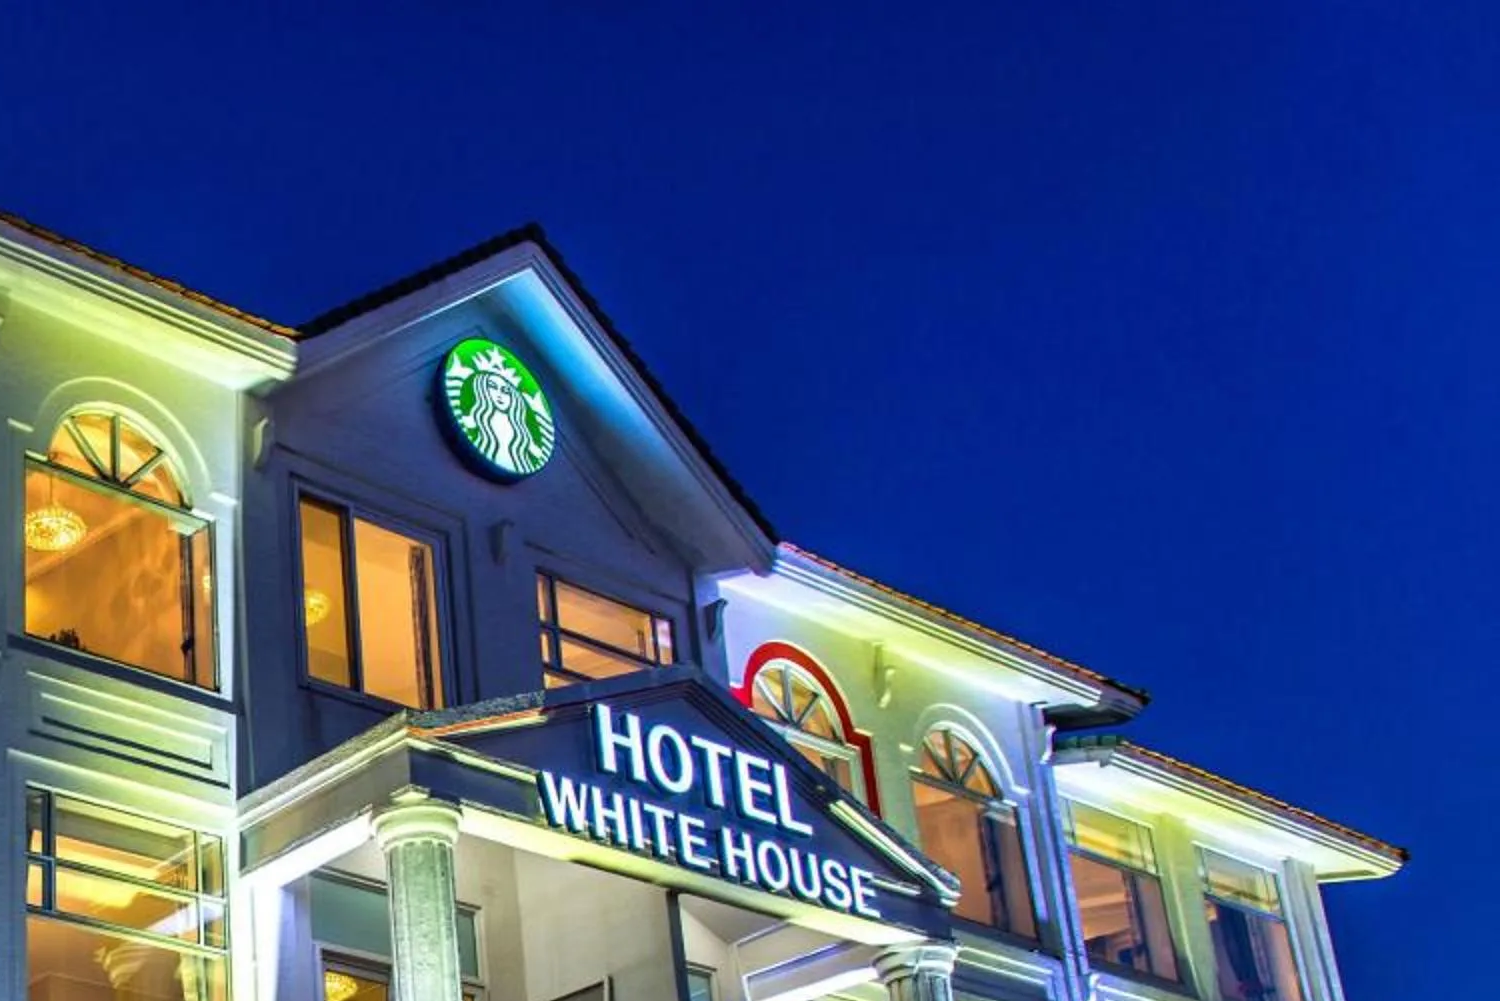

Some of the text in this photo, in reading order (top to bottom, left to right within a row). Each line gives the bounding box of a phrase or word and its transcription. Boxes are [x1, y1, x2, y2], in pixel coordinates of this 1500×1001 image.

[592, 703, 814, 837] HOTEL
[536, 769, 882, 919] WHITE HOUSE
